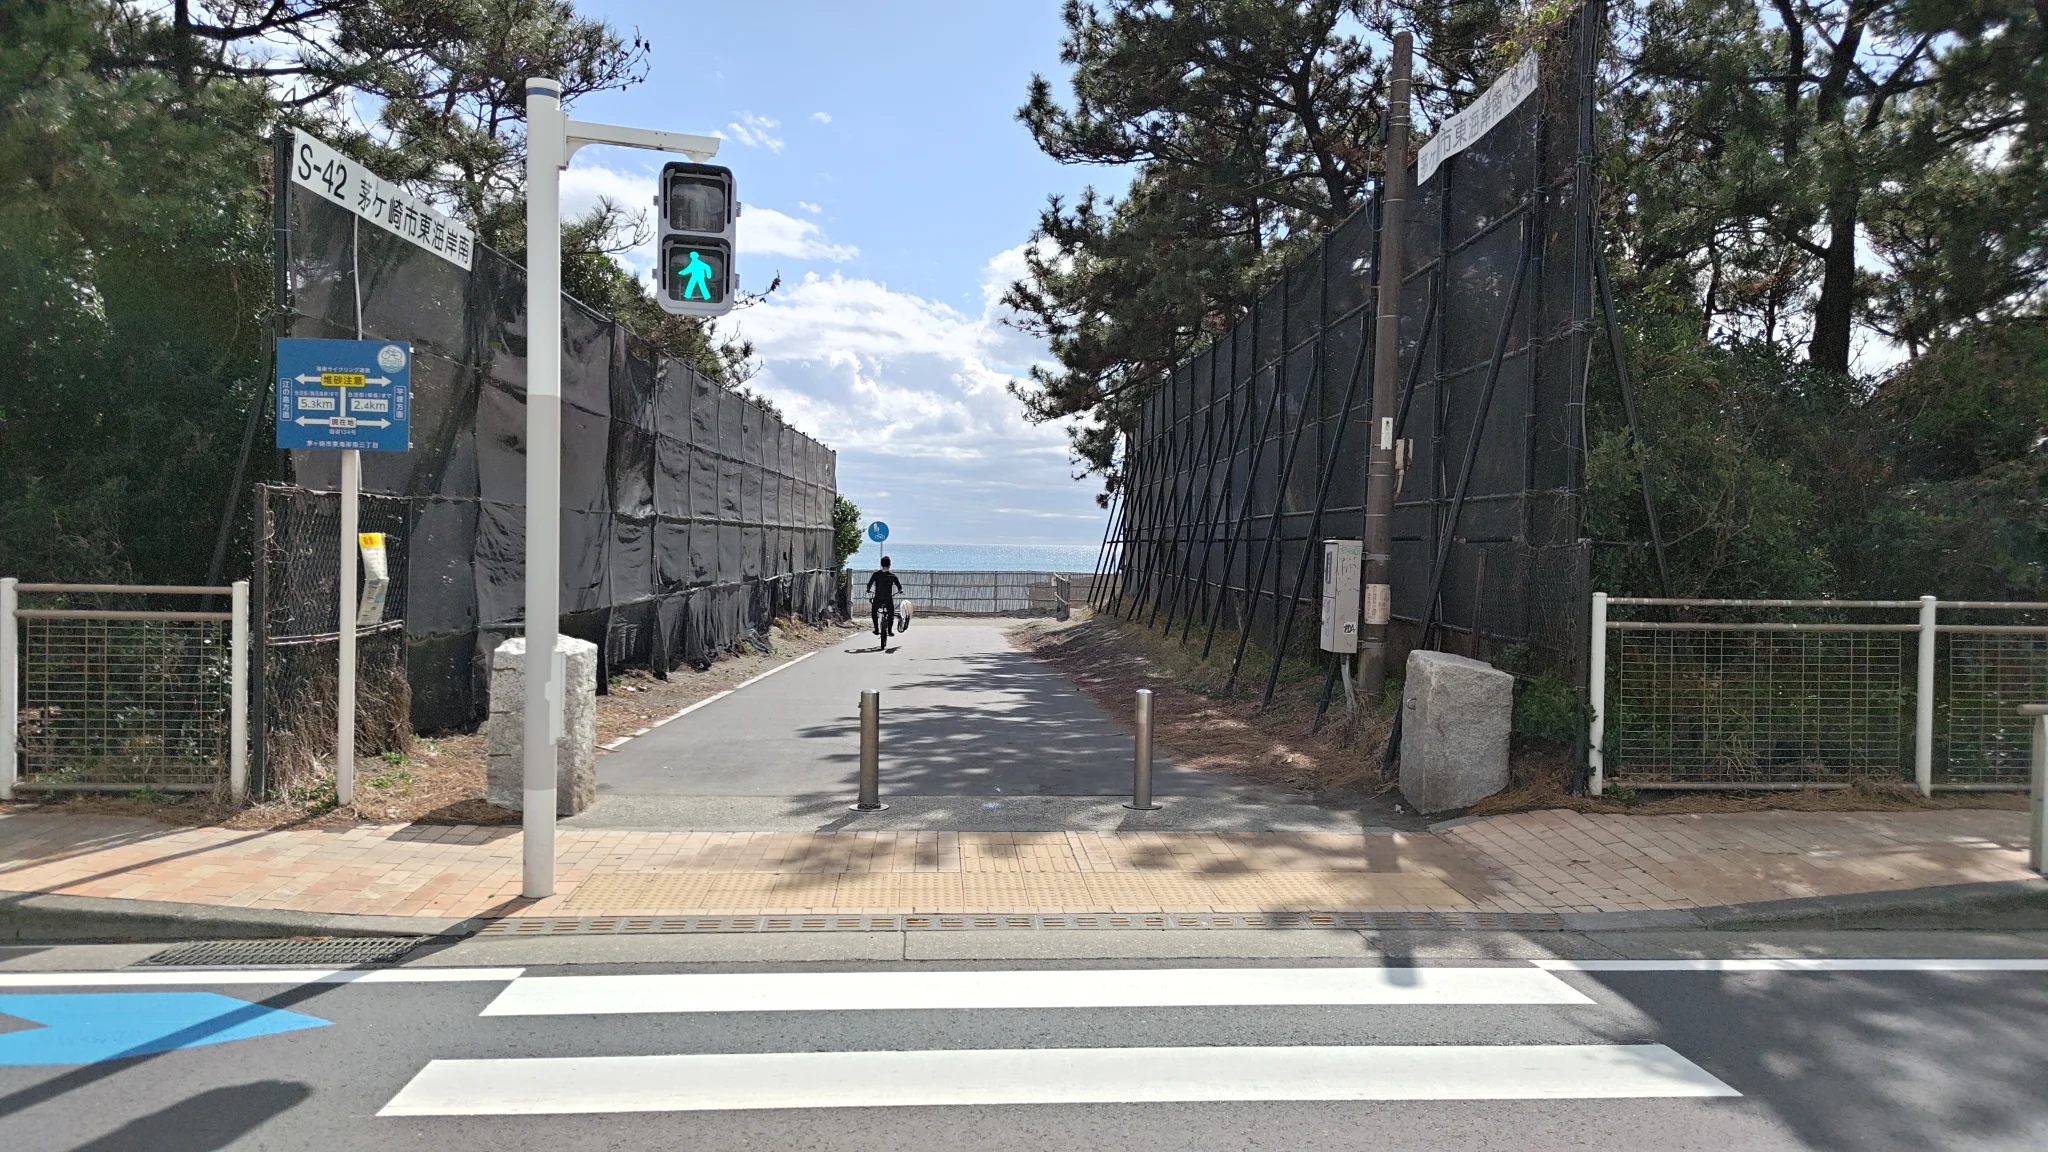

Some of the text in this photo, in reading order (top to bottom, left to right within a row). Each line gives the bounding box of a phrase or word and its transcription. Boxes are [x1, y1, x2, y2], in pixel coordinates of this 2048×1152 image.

[298, 143, 347, 201] S-42
[323, 375, 364, 386] 堆砂注意
[282, 380, 290, 419] 江の島方面
[301, 398, 333, 409] 5.3km
[353, 400, 386, 411] 2.4km
[331, 418, 355, 427] 現在地
